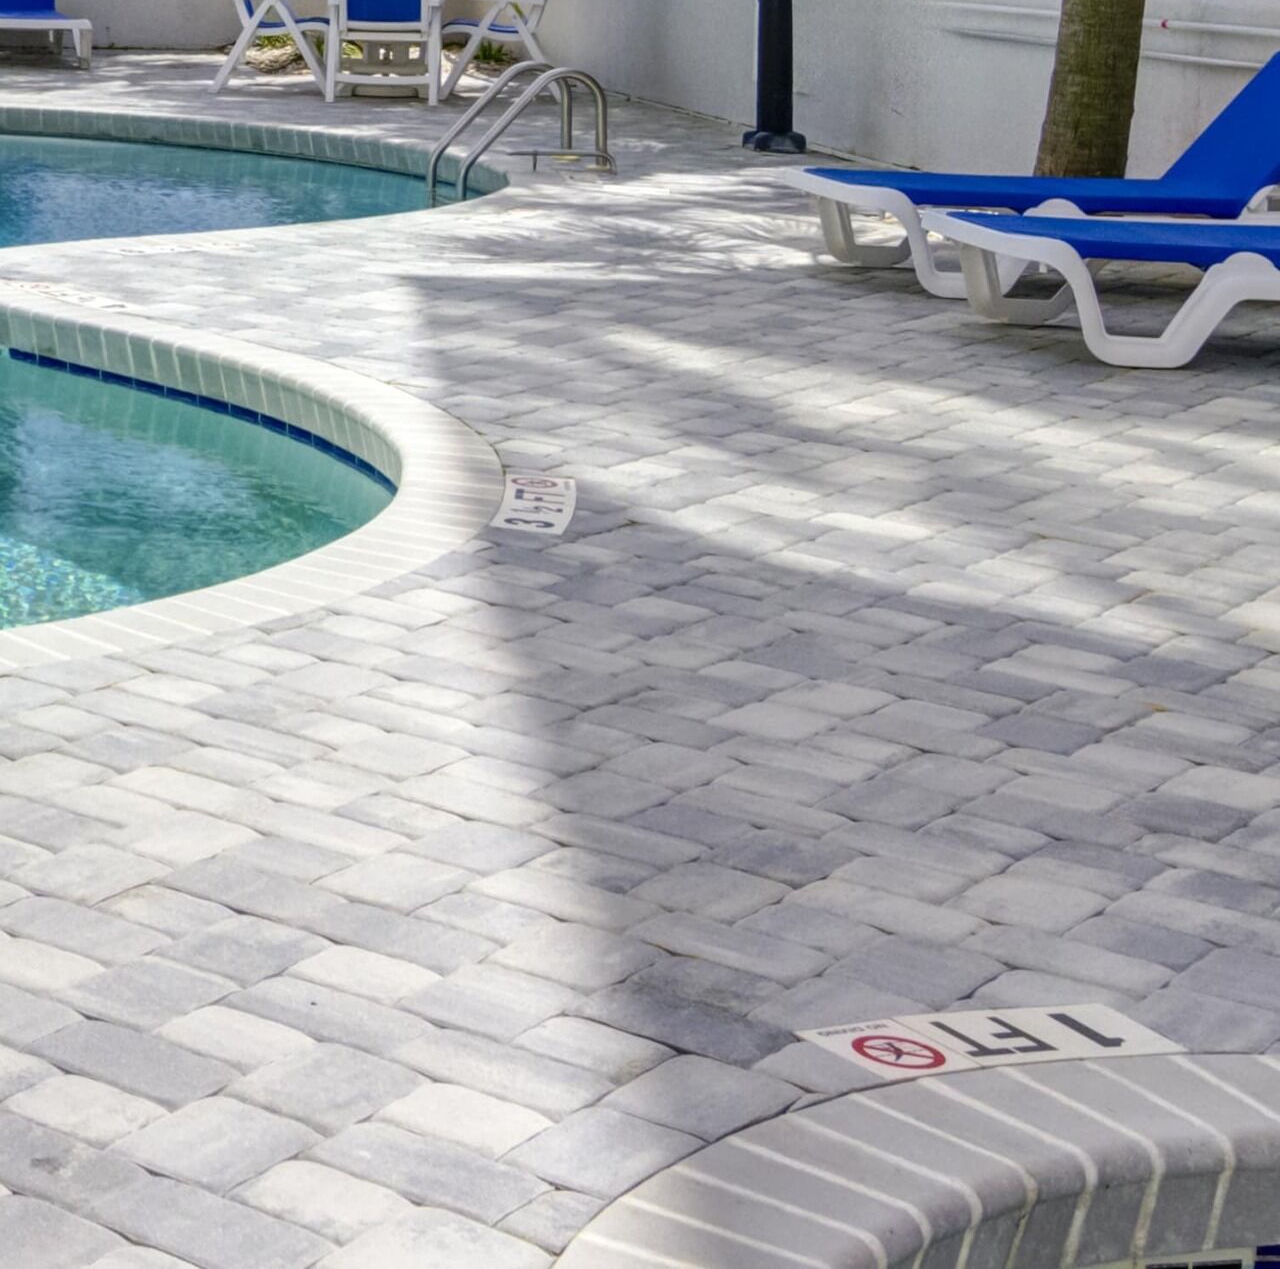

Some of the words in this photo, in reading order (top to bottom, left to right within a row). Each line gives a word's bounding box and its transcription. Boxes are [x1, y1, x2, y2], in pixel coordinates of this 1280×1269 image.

[503, 517, 555, 528] 3
[929, 1016, 1058, 1057] FT
[1048, 1013, 1126, 1048] 1
